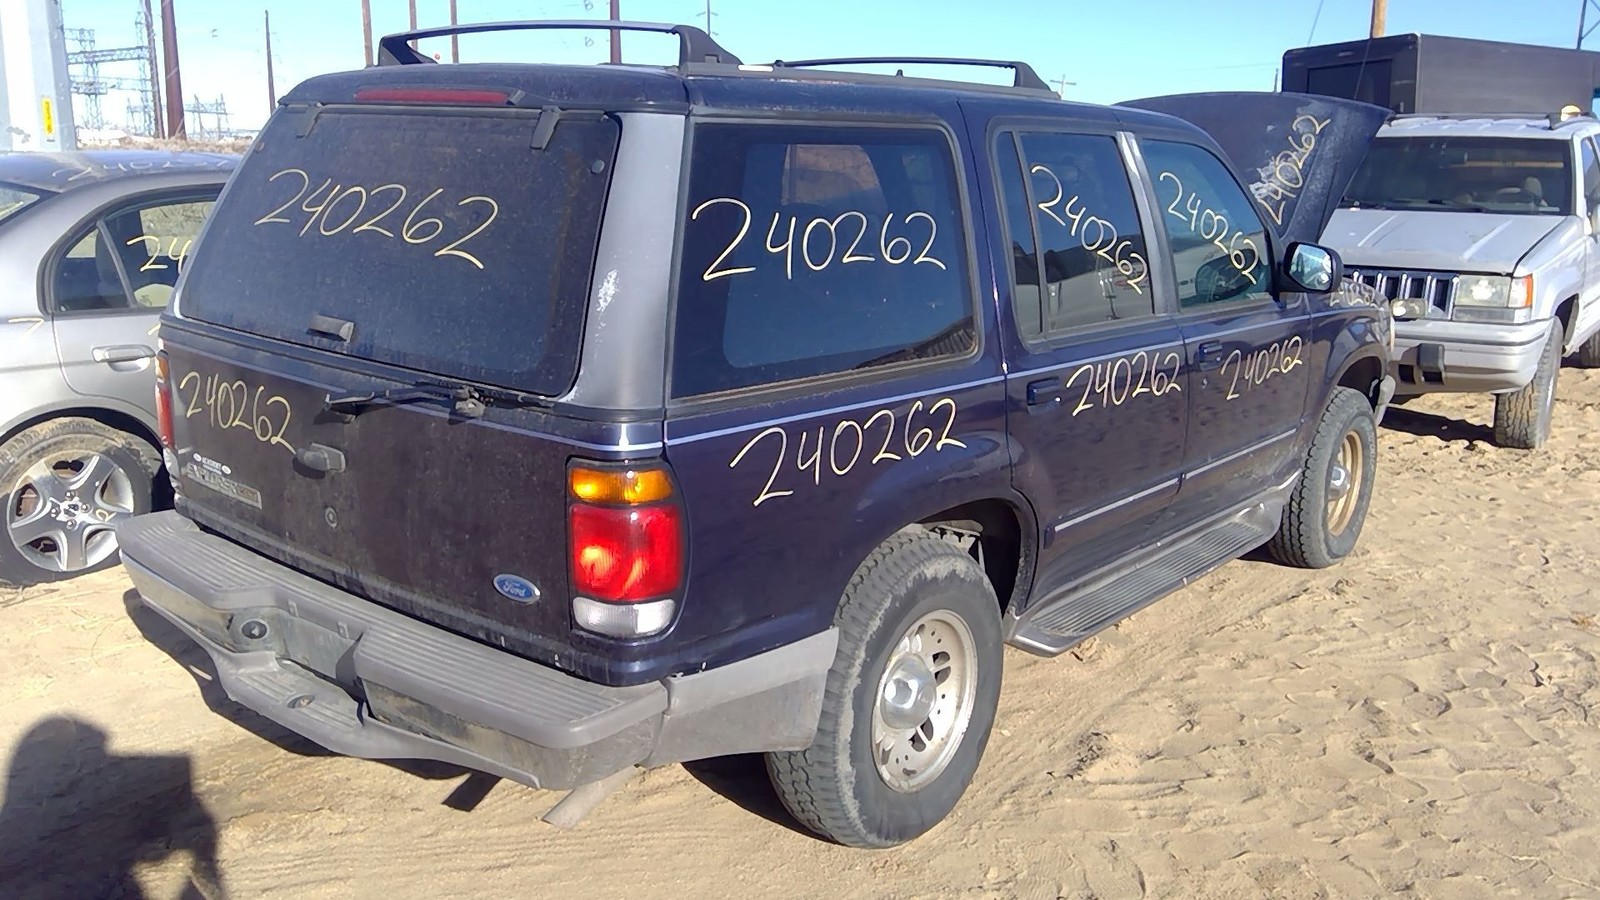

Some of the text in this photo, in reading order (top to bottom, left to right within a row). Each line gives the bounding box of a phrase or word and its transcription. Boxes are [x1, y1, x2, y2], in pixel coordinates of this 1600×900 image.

[254, 167, 498, 270] 240262
[1255, 114, 1331, 226] 240262
[692, 197, 946, 281] 240262
[1031, 165, 1148, 295] 240262
[1160, 171, 1259, 285] 240262
[180, 371, 296, 453] 240262
[1065, 351, 1182, 416] 240262
[1221, 335, 1304, 401] 240262
[729, 398, 967, 507] 240262
